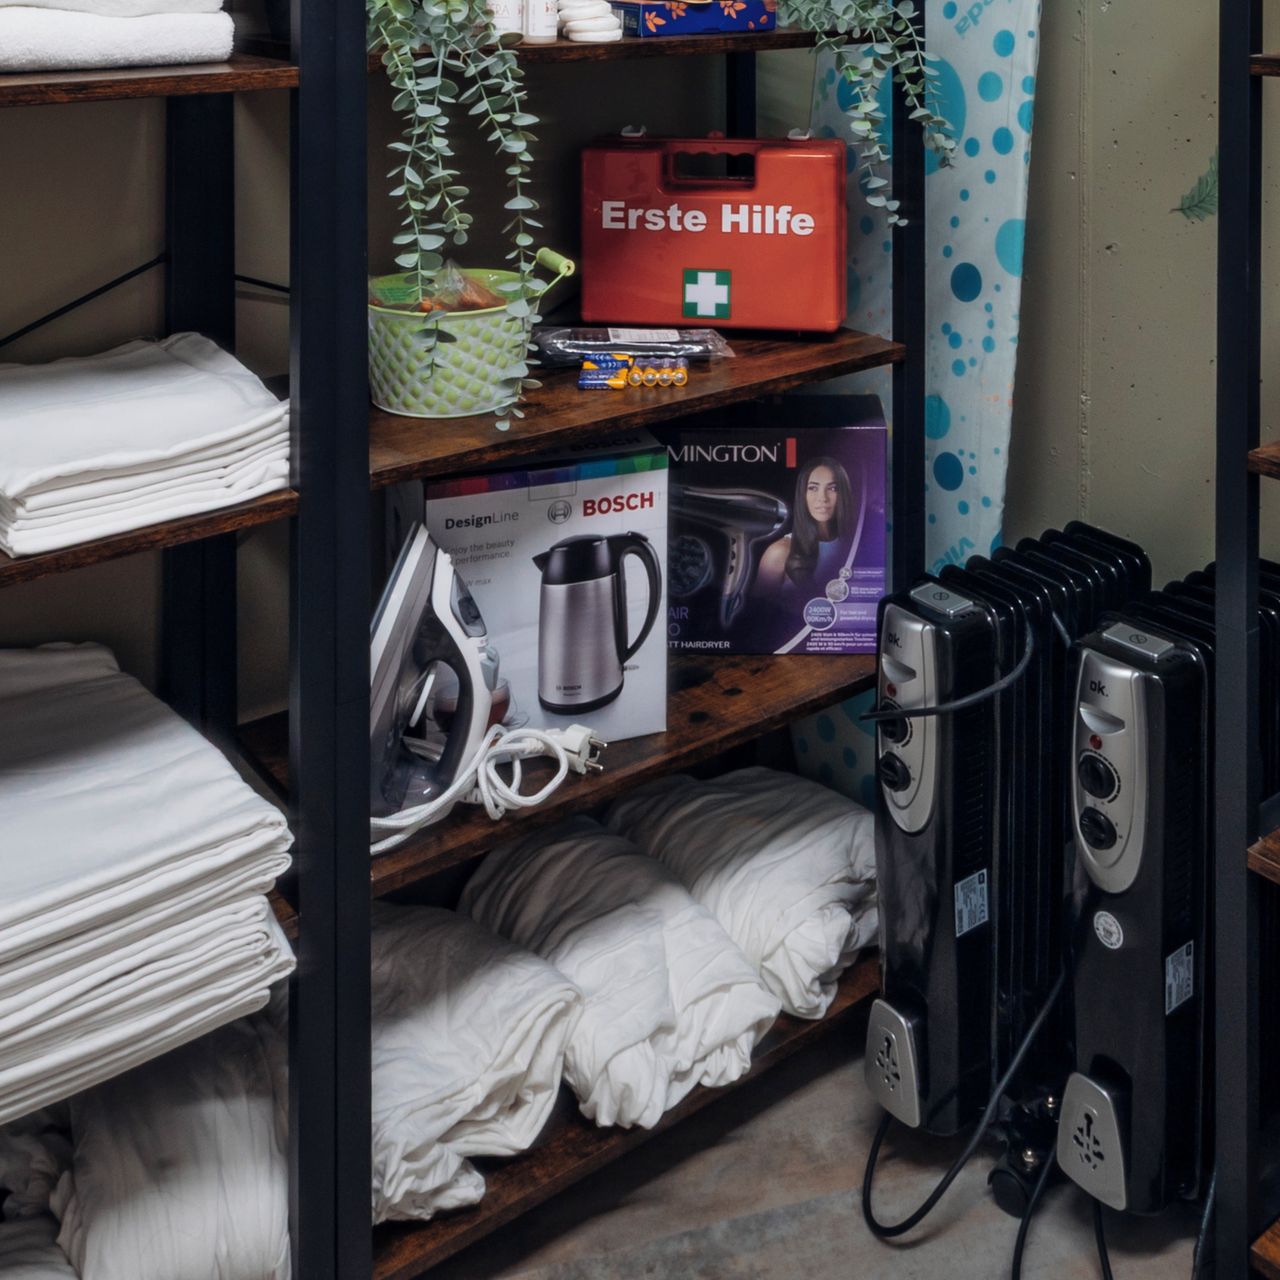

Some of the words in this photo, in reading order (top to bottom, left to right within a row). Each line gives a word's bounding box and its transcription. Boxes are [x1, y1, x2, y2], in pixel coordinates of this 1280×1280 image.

[601, 200, 707, 232] Erste
[721, 203, 815, 236] Hilfe
[583, 491, 654, 517] BOSCH
[445, 511, 519, 530] DesignLine
[469, 542, 484, 551] the
[486, 539, 515, 551] beauty
[681, 640, 731, 649] HAIRDRYER
